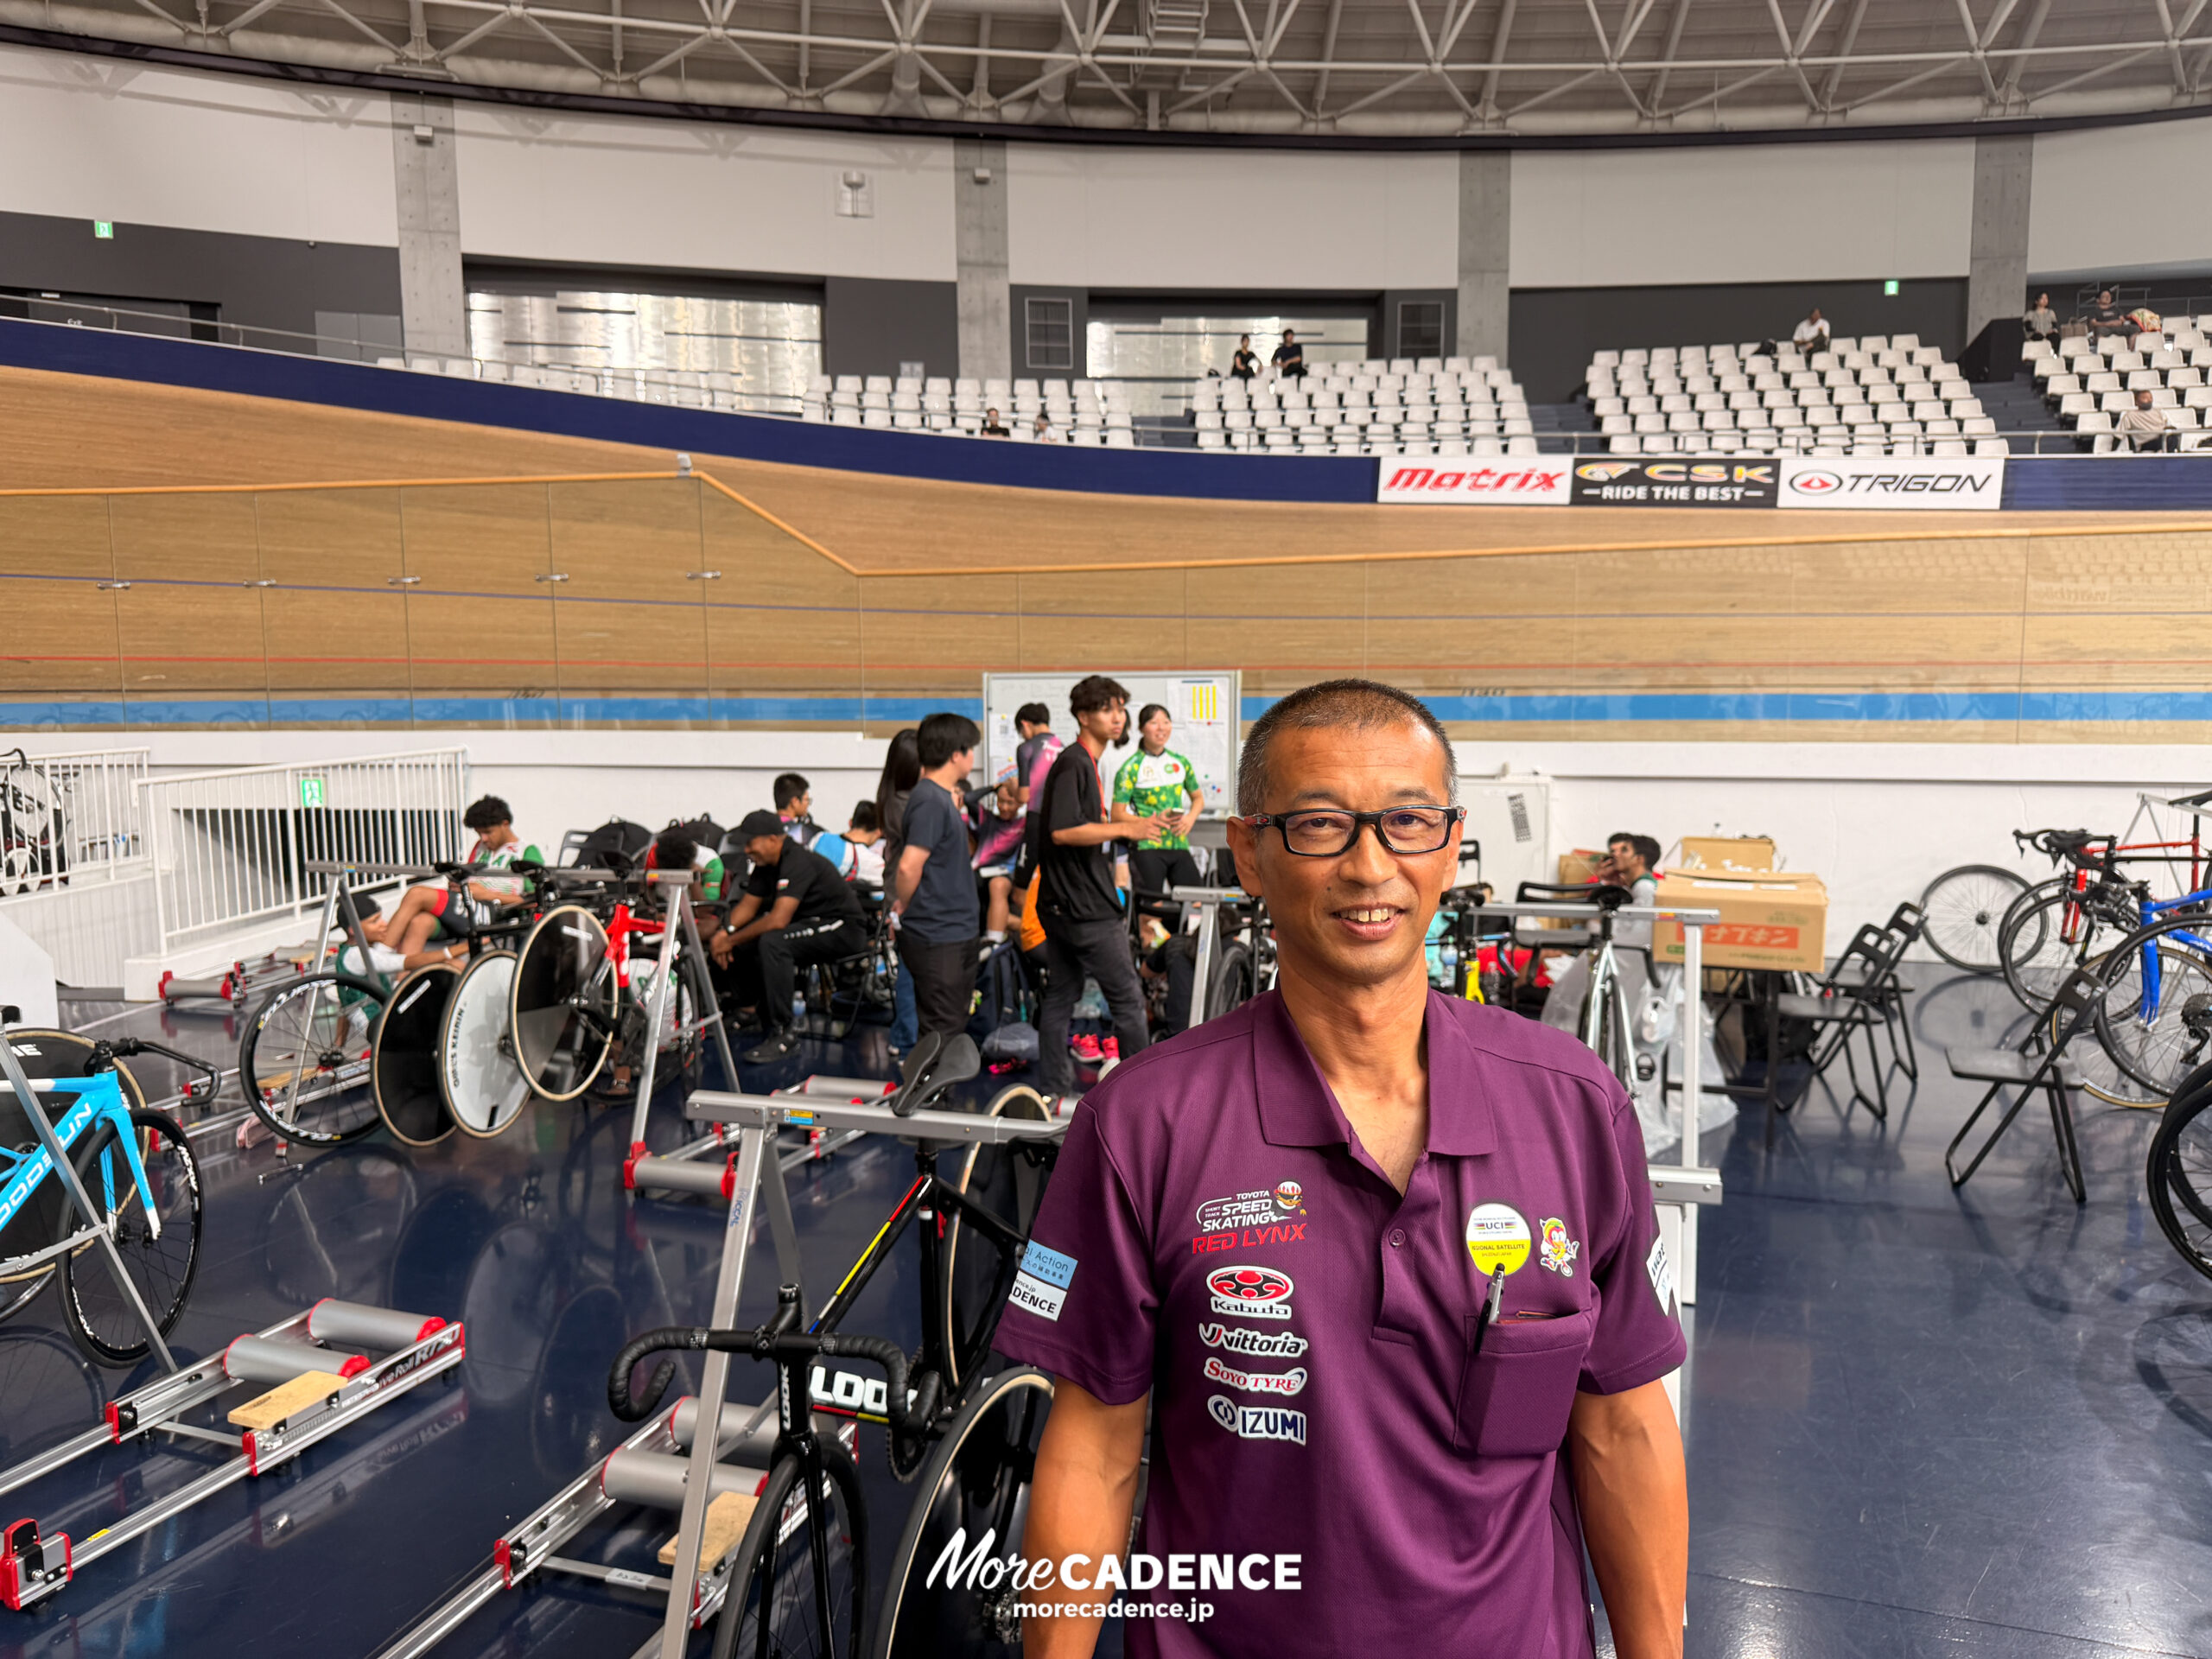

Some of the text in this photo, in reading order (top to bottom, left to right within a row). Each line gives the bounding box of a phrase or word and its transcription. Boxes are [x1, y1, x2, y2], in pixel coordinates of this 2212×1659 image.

[1383, 467, 1566, 492] Matrix
[1645, 463, 1773, 483] CSK
[1847, 474, 1993, 493] TRIGON
[1601, 486, 1744, 500] RIDE THE BEST
[1236, 1191, 1270, 1200] TOYOTA
[1222, 1199, 1272, 1216] SPEED
[1202, 1211, 1270, 1232] SKATING
[1192, 1224, 1306, 1254] RED LYNX
[1035, 1251, 1069, 1272] Action
[1207, 1361, 1299, 1391] SOYO TYRE
[780, 1362, 791, 1431] LOOK
[1242, 1410, 1304, 1440] IZUMI
